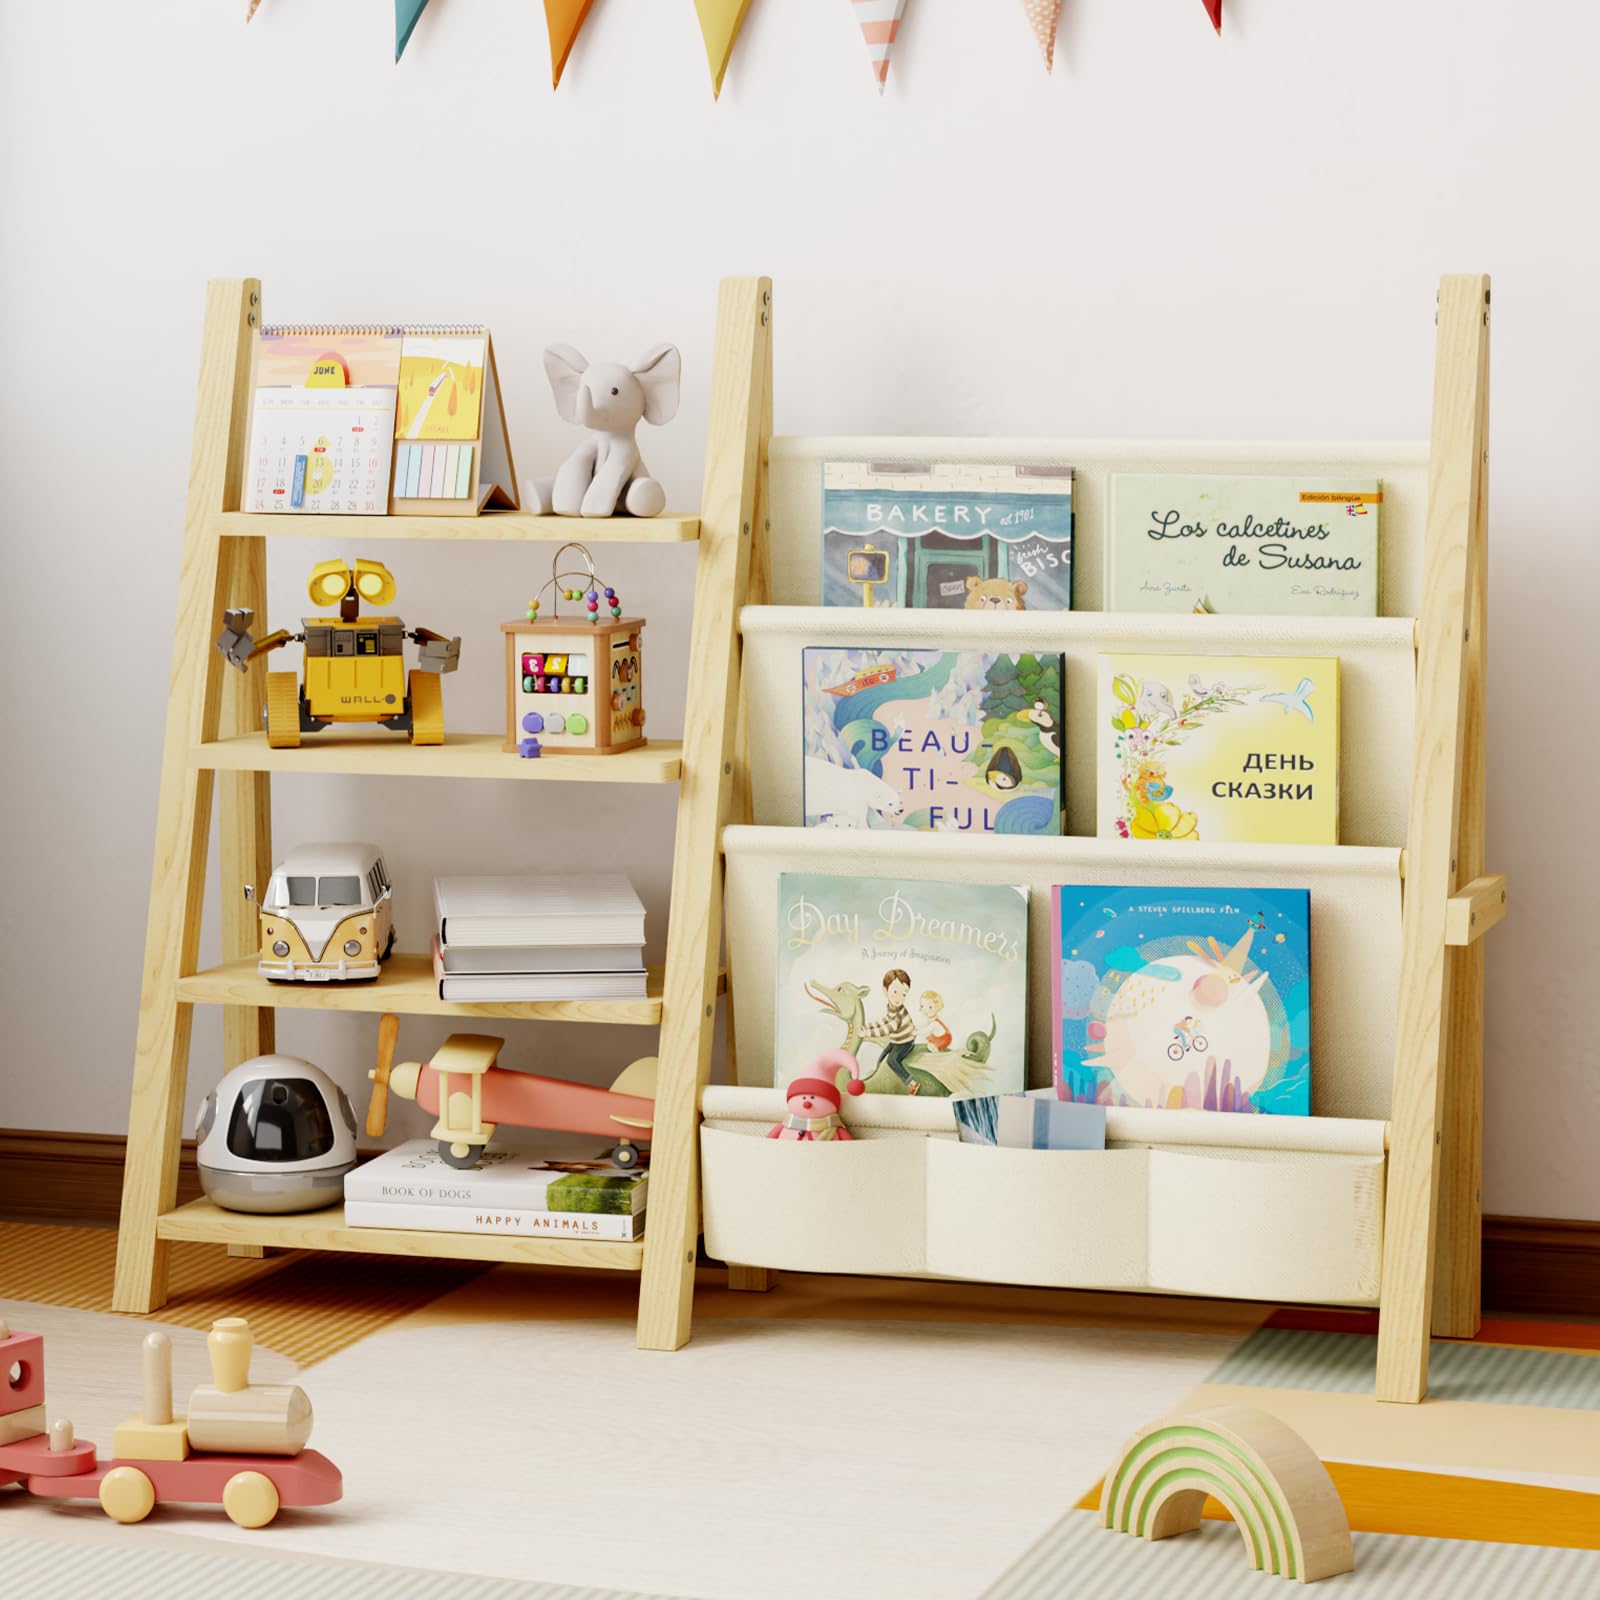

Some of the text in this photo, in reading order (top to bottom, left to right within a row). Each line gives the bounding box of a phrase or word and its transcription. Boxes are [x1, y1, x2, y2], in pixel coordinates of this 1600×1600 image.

[313, 366, 335, 375] JUNE
[1301, 493, 1330, 501] Edición
[866, 503, 992, 524] BAKERY
[1147, 510, 1330, 541] Los calcetines
[1017, 544, 1049, 565] fresh
[1223, 543, 1362, 570] de Susana
[871, 729, 993, 754] BEAU-
[1242, 753, 1315, 774] ДЕНЬ
[902, 768, 959, 791] TI-
[1211, 781, 1313, 801] СКАЗКИ
[929, 806, 995, 831] FUL
[1128, 905, 1240, 914] A STEVEN SPIELBERG FILM
[786, 889, 1020, 962] Day Dreamers
[861, 947, 952, 965] A Journey of Imagination
[381, 1186, 472, 1200] BOOK OF DOGS
[475, 1214, 600, 1231] HAPPY ANIMALS
